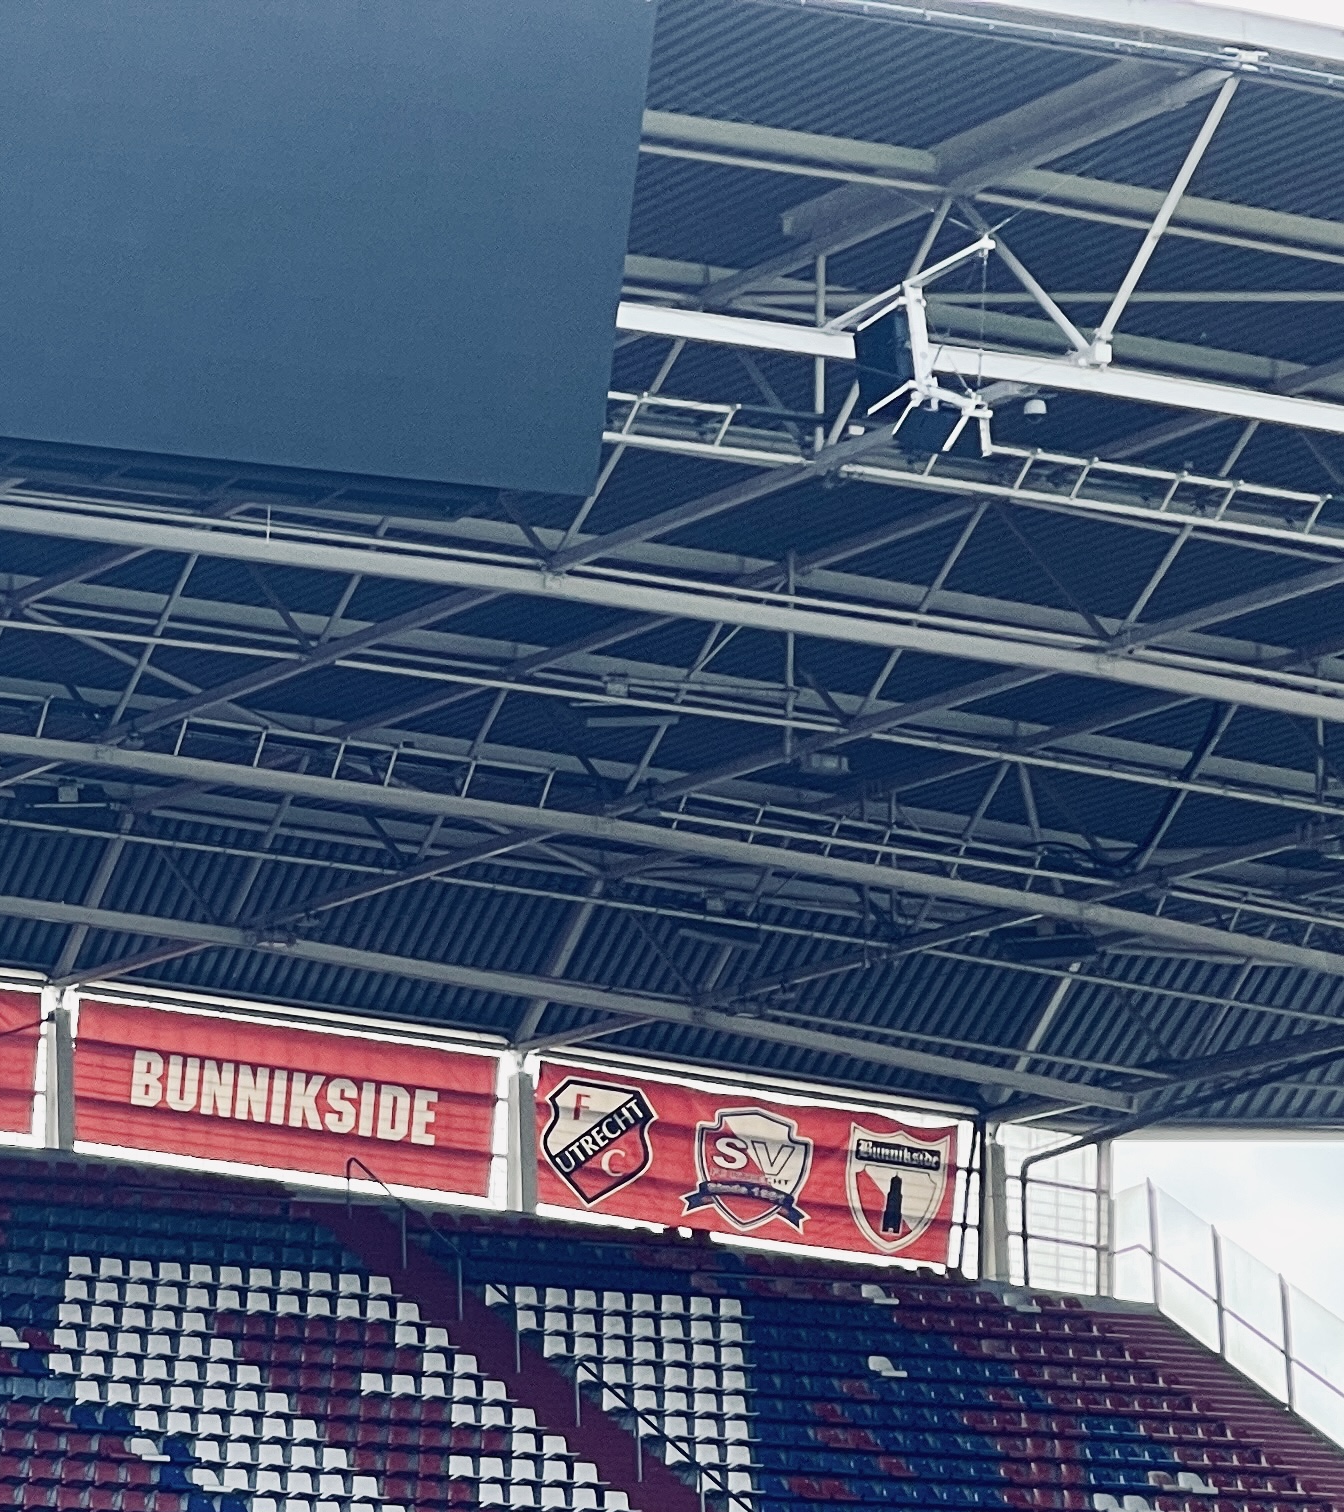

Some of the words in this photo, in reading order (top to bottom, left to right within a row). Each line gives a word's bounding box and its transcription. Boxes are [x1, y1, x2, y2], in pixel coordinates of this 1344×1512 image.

[130, 1049, 439, 1146] BUNNIKSIDE
[573, 1093, 591, 1120] F
[555, 1099, 644, 1173] UTRECHT
[601, 1148, 626, 1177] C
[712, 1137, 795, 1177] SV
